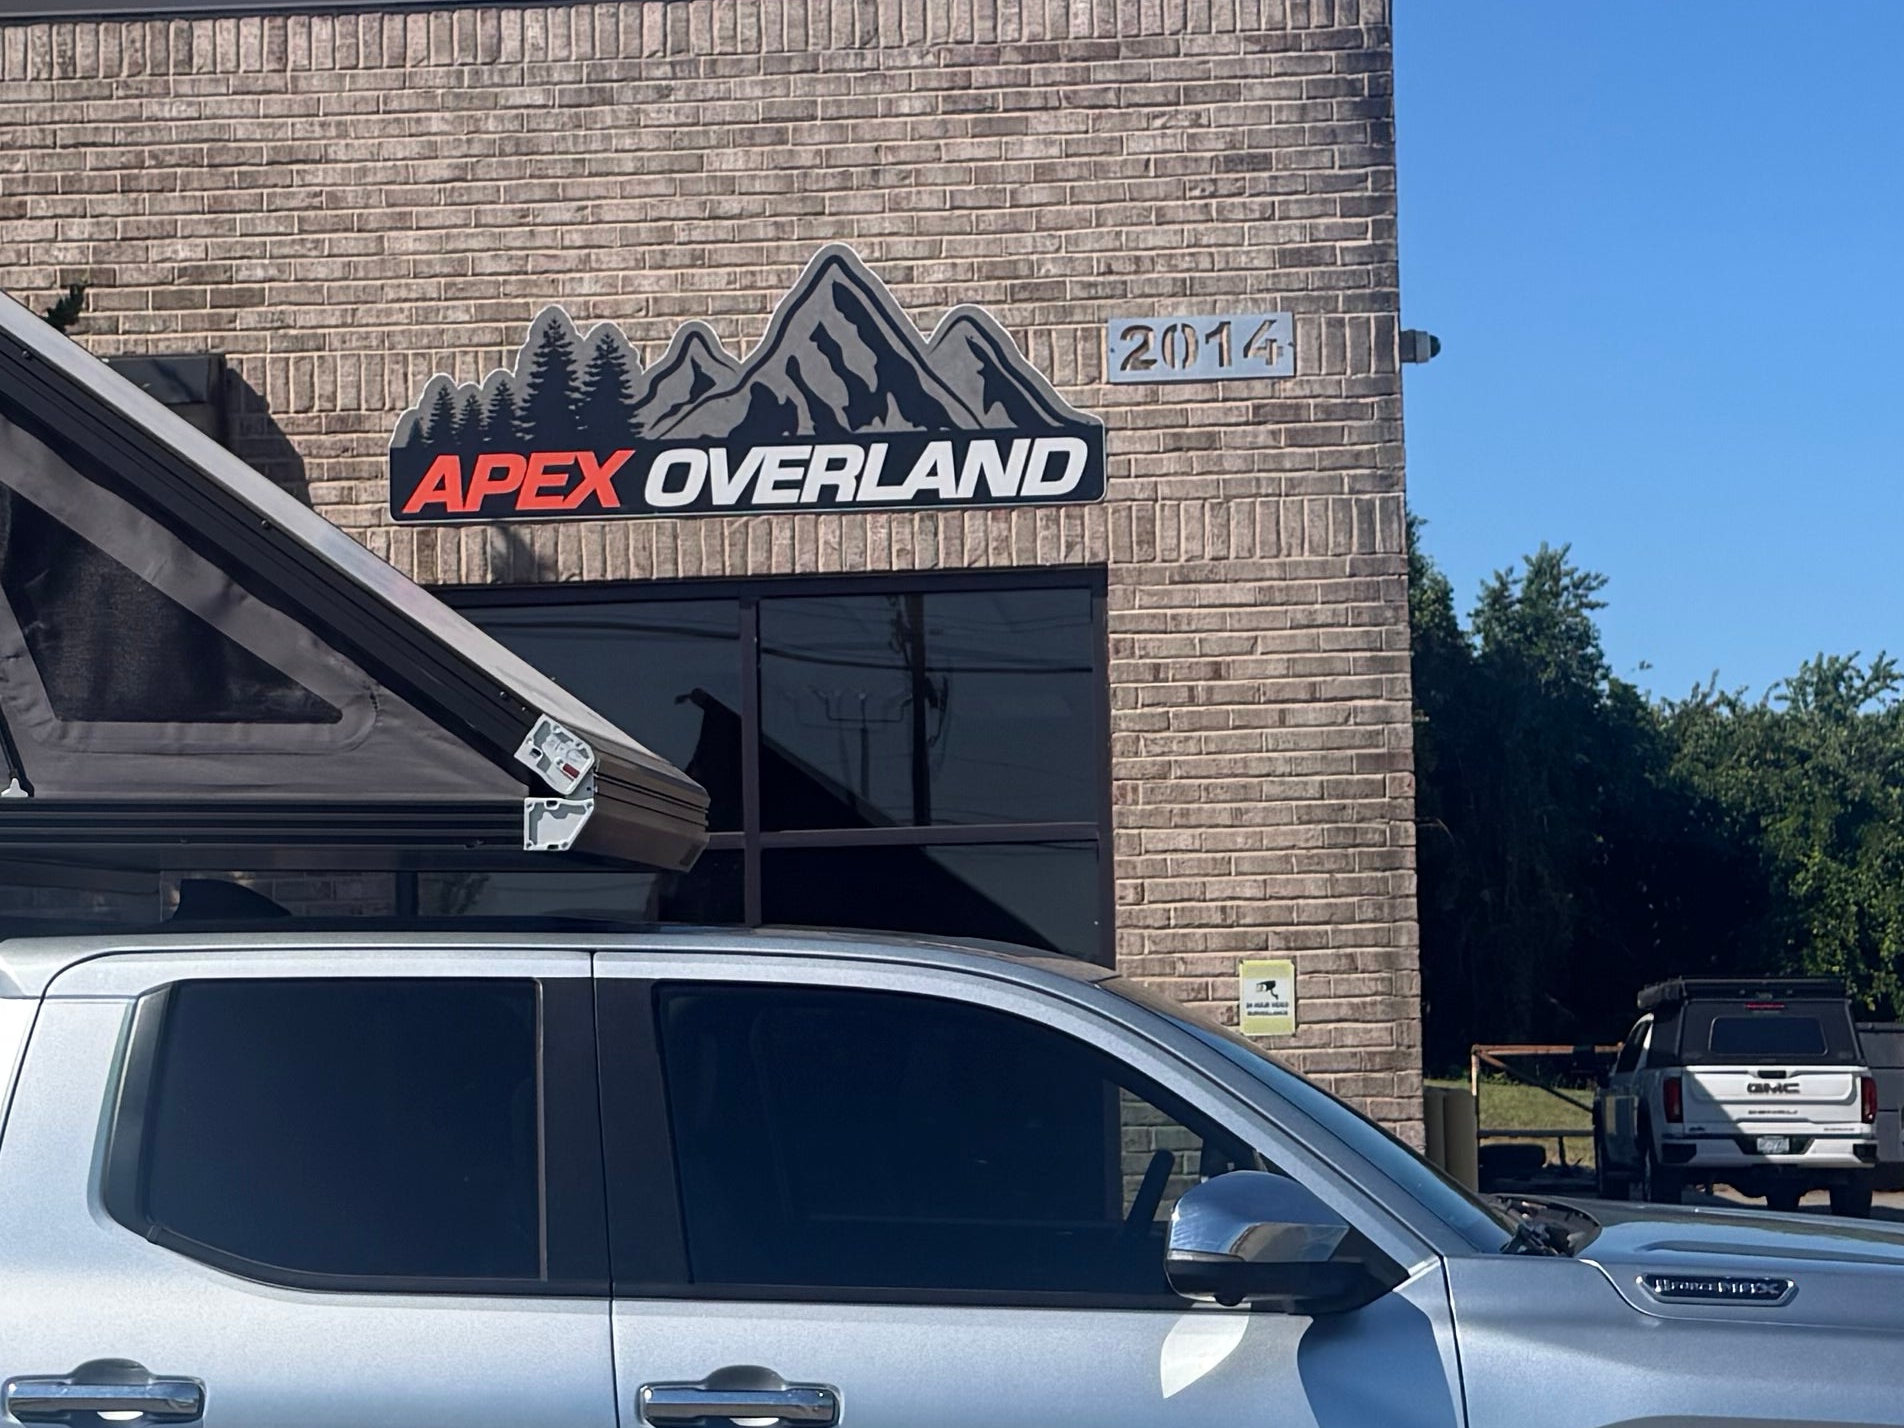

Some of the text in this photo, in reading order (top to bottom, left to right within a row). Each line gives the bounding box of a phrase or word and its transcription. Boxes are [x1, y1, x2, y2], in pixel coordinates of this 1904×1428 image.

[1119, 318, 1284, 371] 2014
[401, 436, 1089, 514] APEX OVERLAND
[1747, 1082, 1801, 1094] GMC
